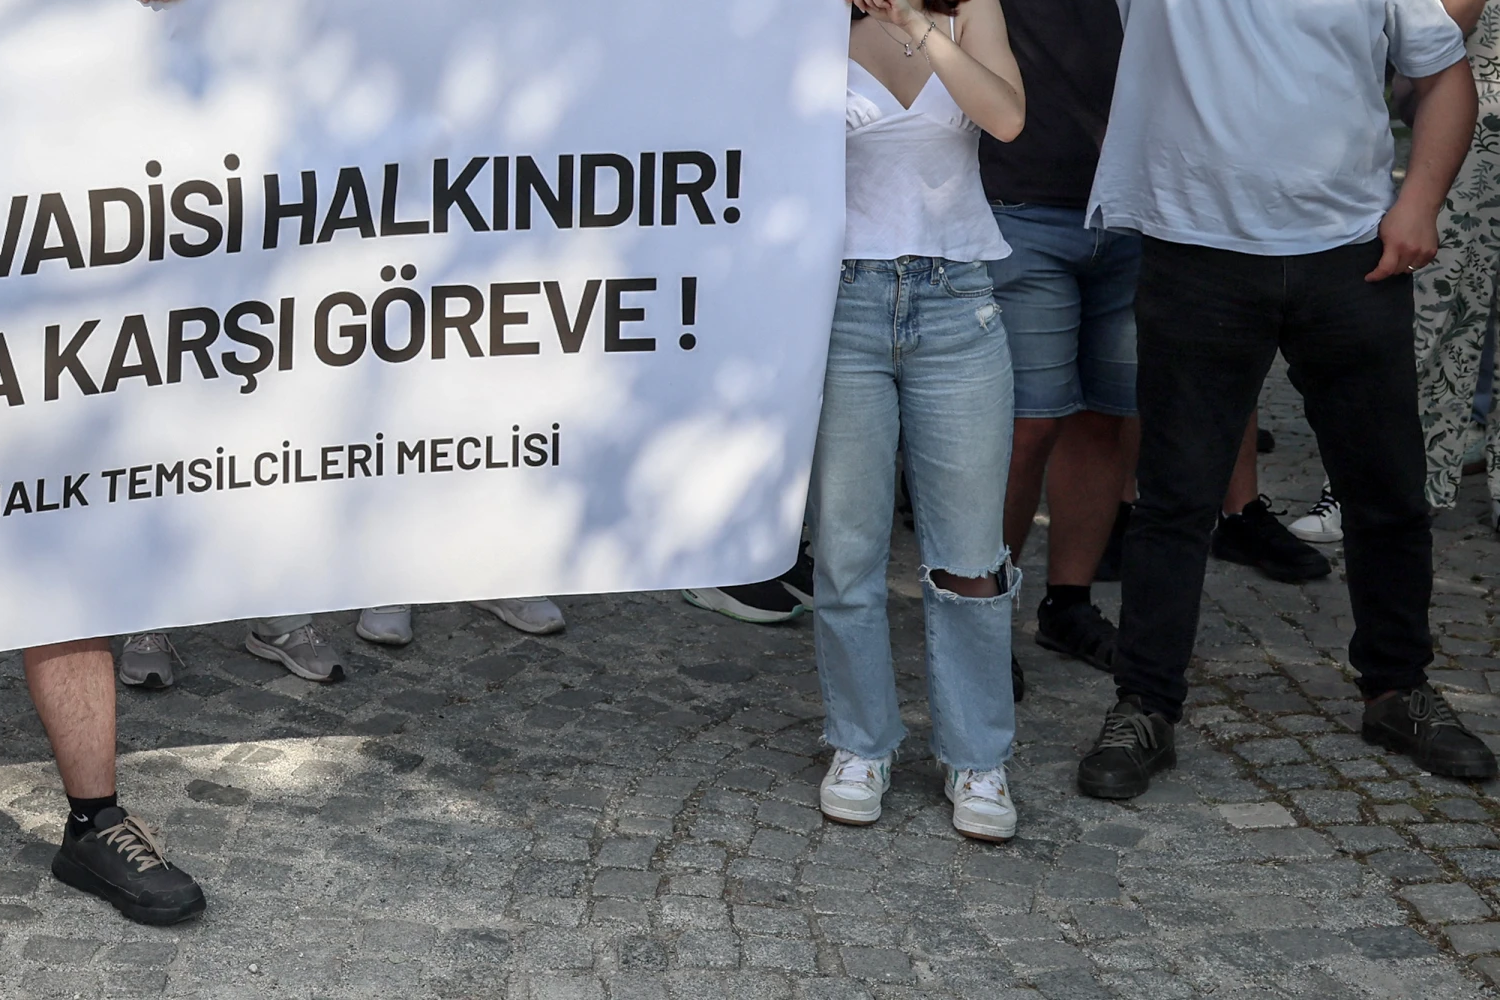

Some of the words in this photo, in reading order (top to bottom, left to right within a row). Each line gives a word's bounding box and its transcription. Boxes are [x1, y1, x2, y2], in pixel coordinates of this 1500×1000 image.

[261, 149, 743, 251] HALKINDIR!
[43, 297, 296, 403] KARŞI
[313, 262, 658, 368] GÖREVE
[678, 275, 699, 352] !
[100, 431, 385, 504] TEMSİLCİLERİ
[396, 421, 561, 476] MECLİSİ
